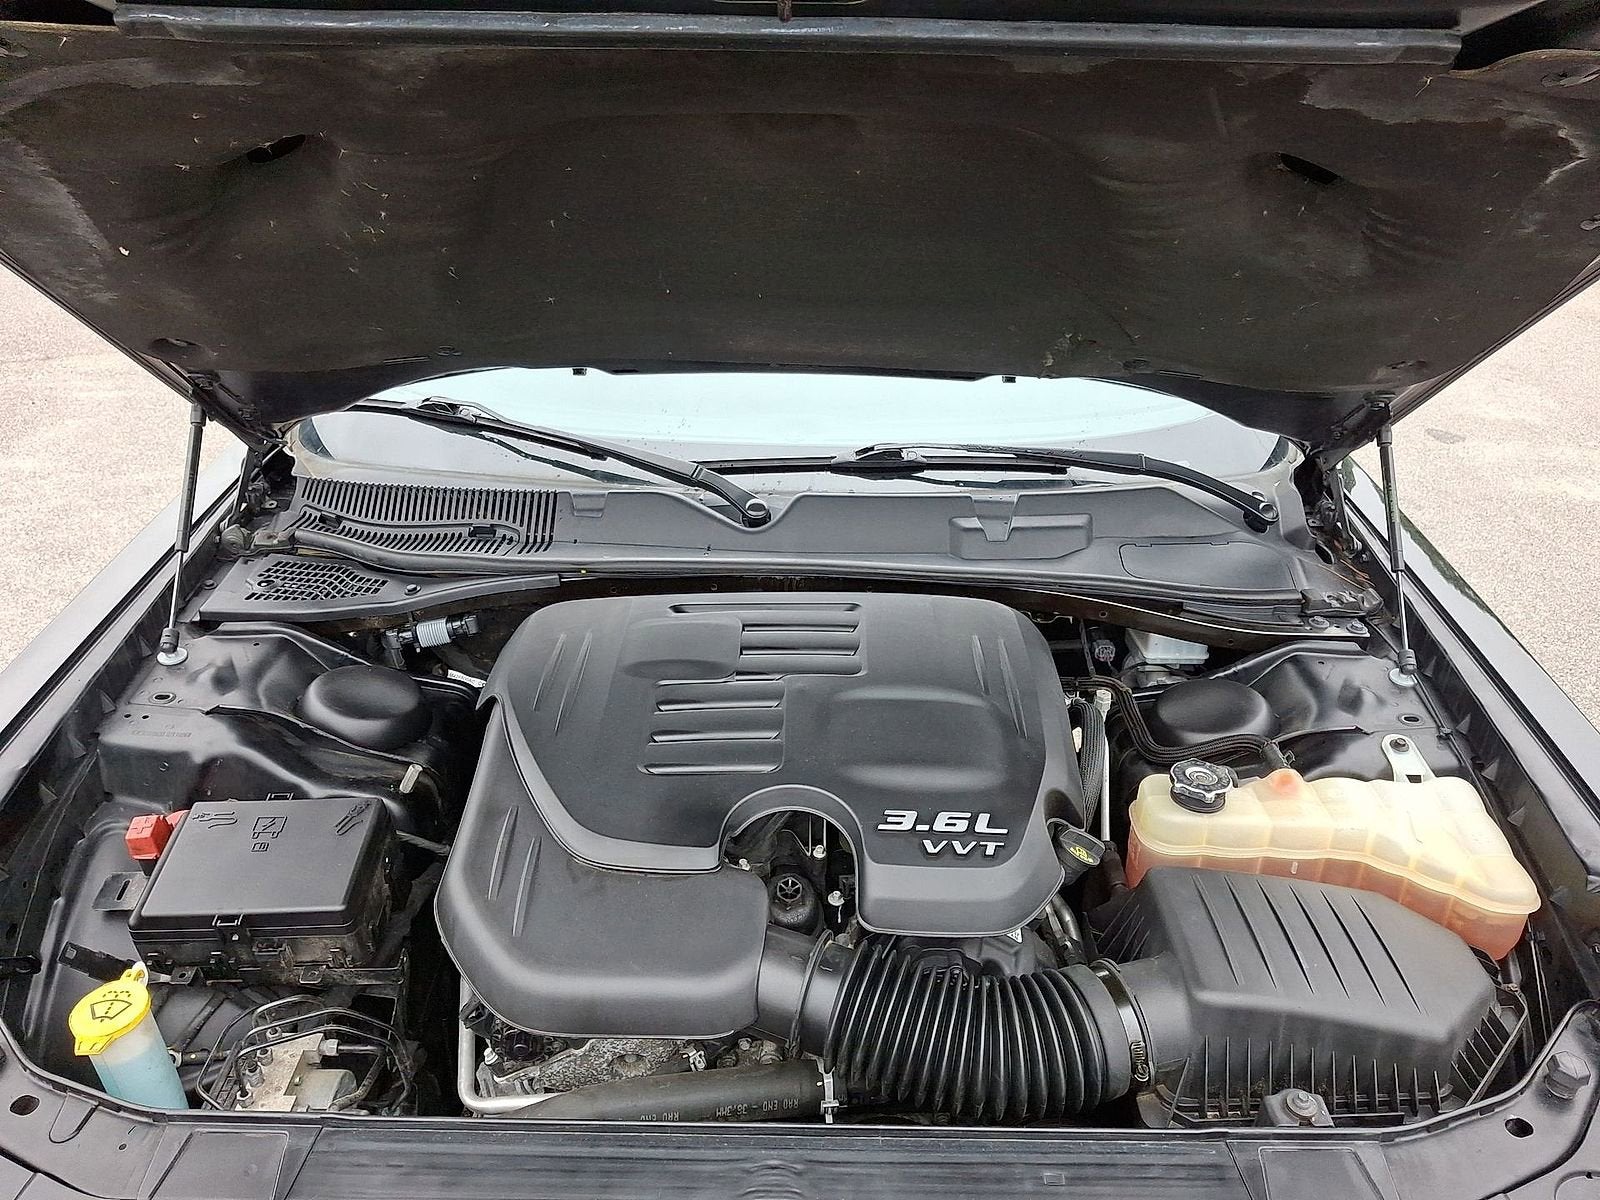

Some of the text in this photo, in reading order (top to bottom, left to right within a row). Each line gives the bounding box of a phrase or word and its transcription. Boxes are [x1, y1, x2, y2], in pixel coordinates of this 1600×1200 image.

[877, 809, 1009, 834] 3.6L
[922, 839, 1005, 856] VVT
[762, 1100, 778, 1112] END
